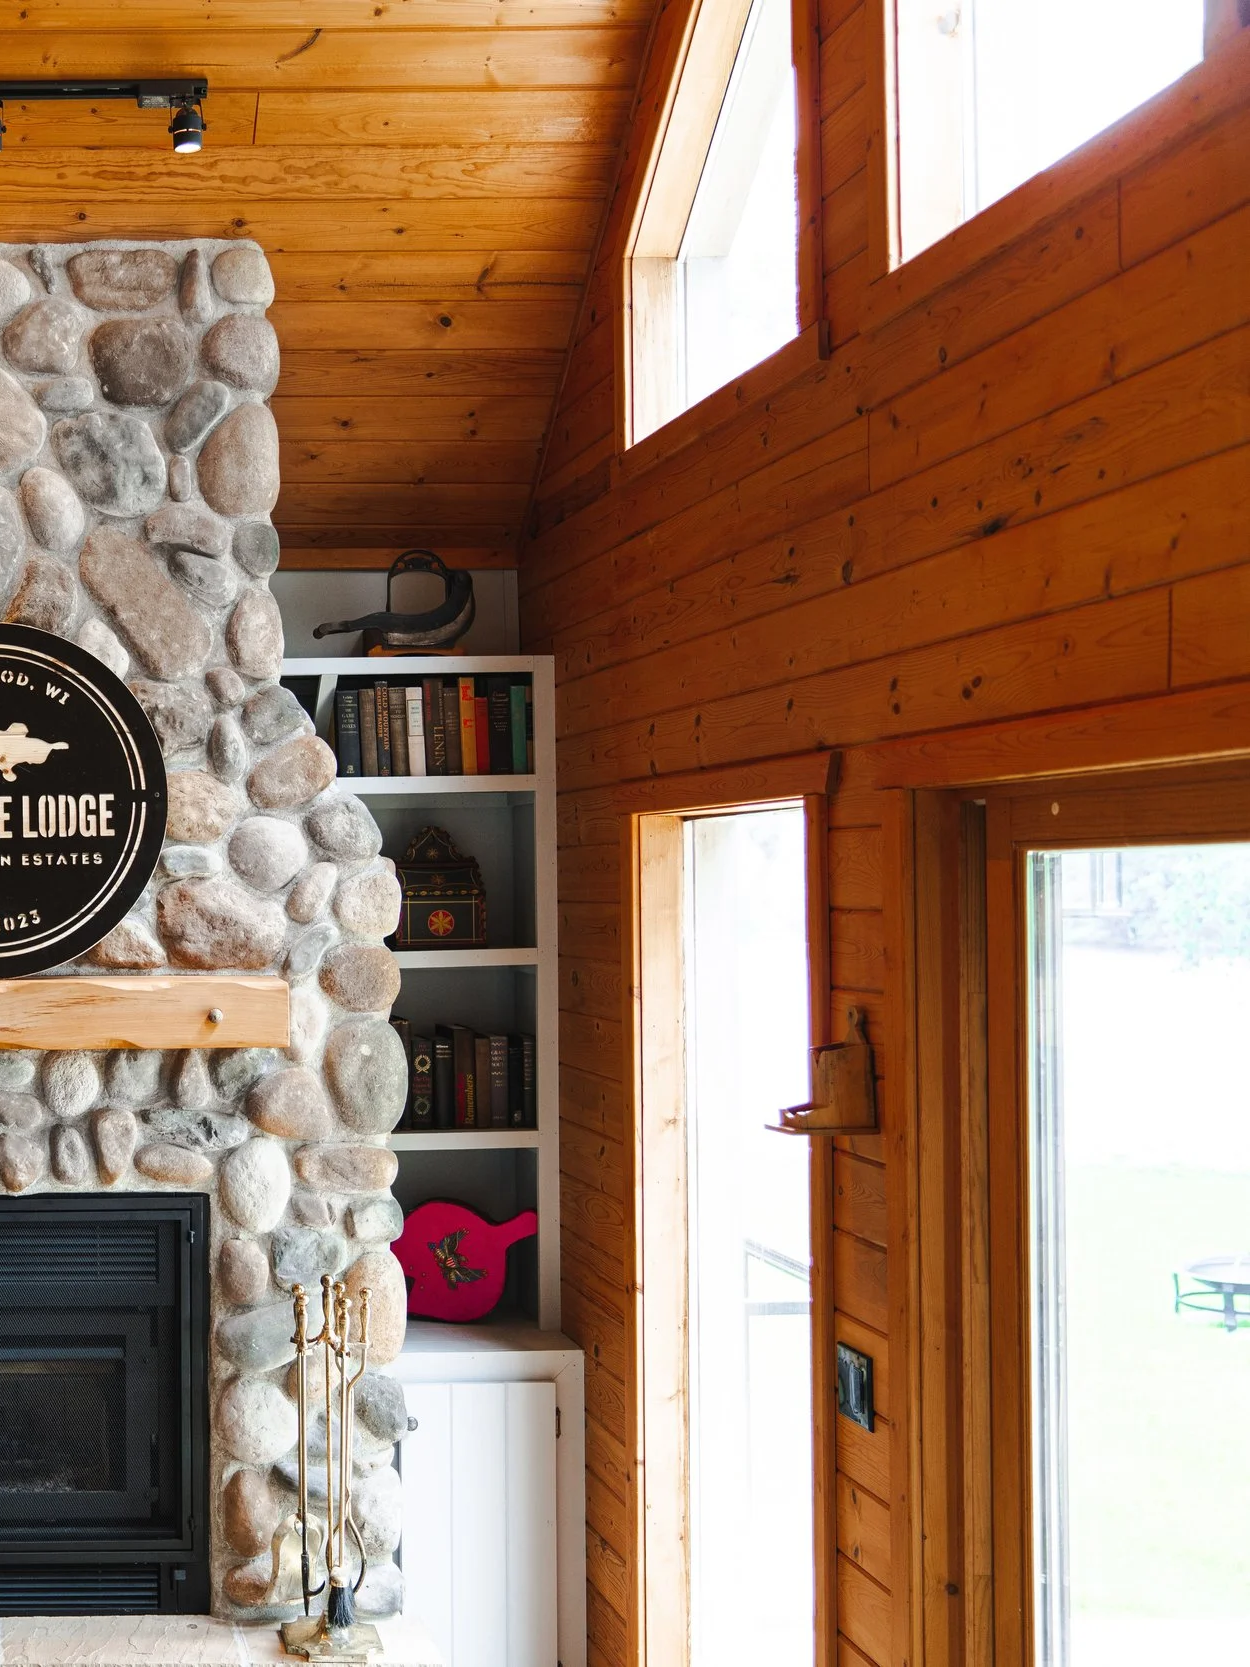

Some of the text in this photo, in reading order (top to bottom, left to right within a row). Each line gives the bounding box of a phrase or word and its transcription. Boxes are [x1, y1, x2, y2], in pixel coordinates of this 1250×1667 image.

[45, 682, 71, 706] WI
[433, 726, 446, 766] LENIN
[21, 793, 116, 839] LODGE
[21, 851, 103, 866] ESTATES
